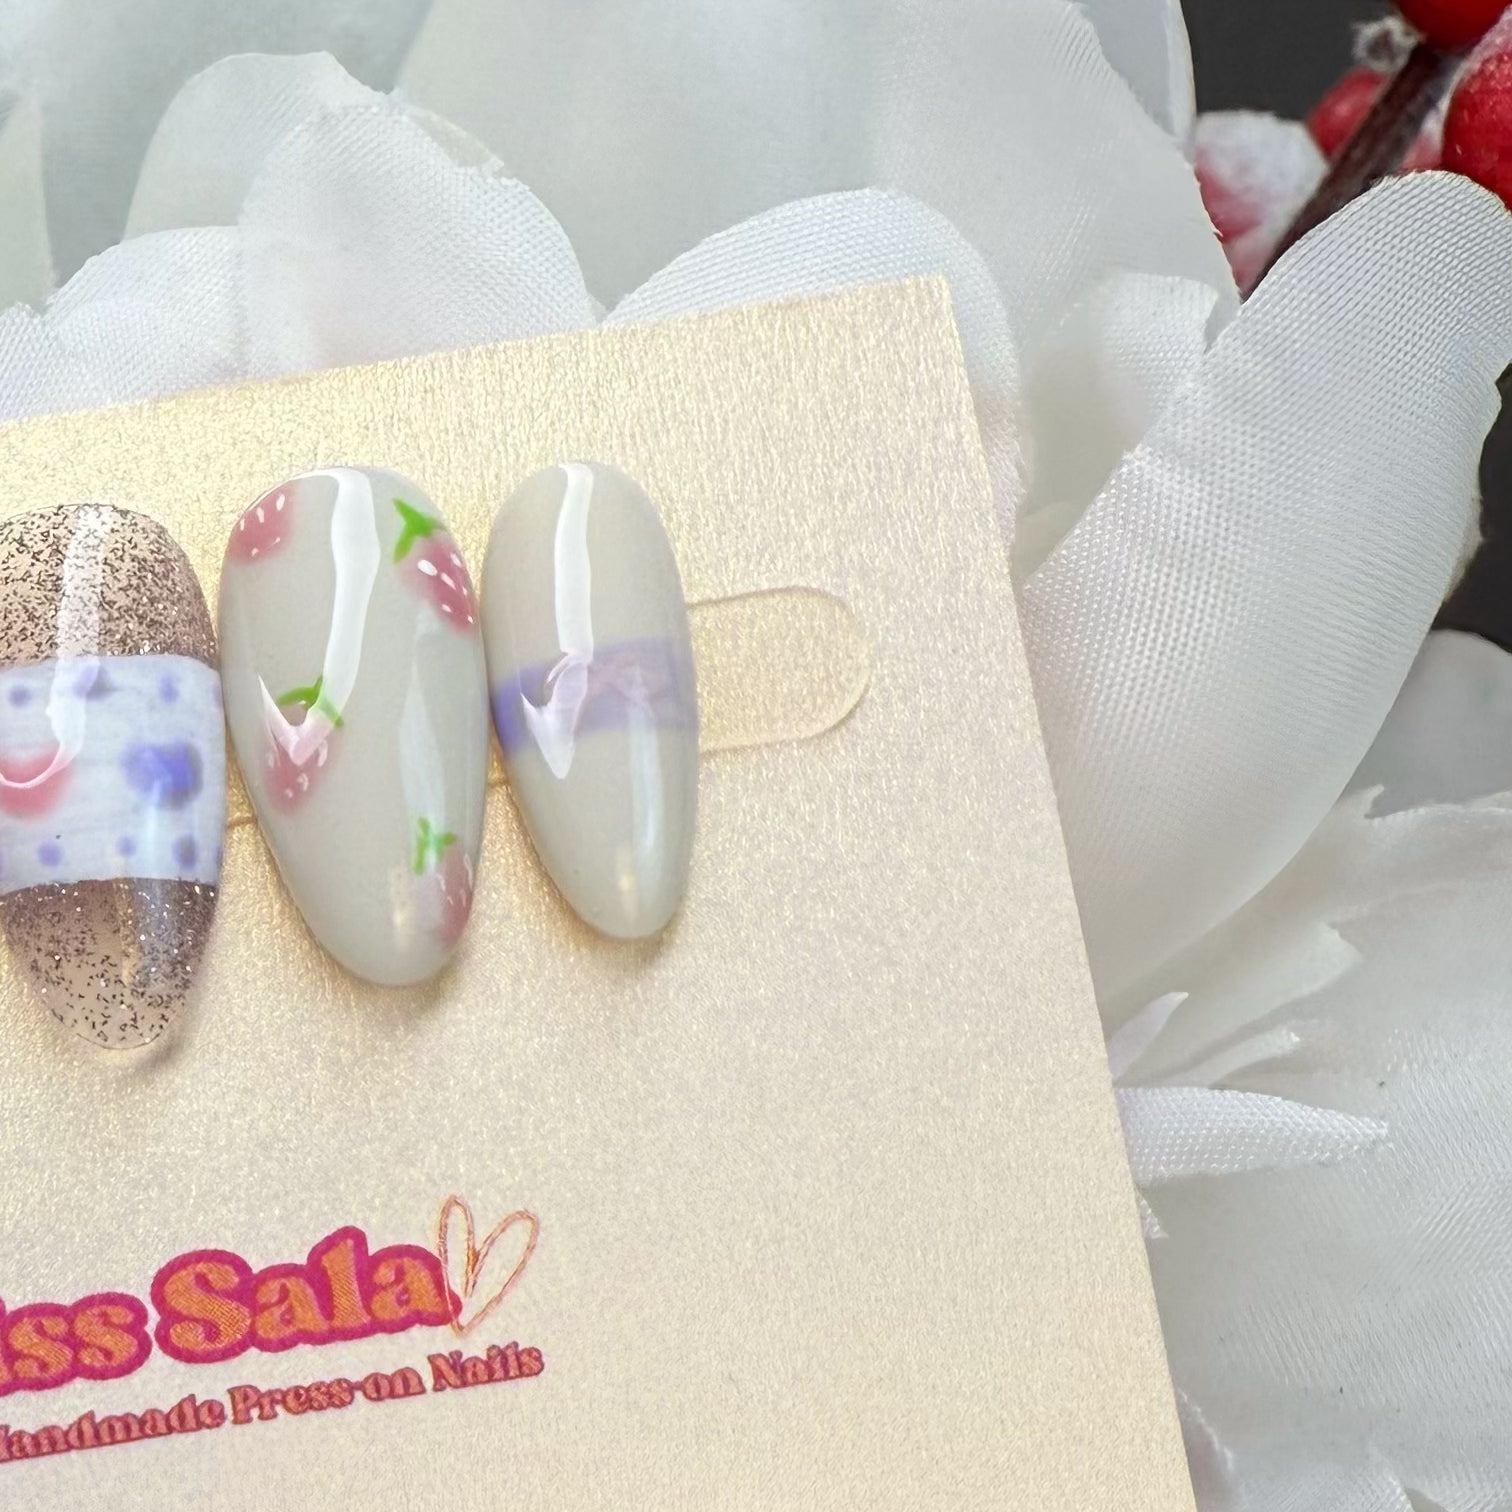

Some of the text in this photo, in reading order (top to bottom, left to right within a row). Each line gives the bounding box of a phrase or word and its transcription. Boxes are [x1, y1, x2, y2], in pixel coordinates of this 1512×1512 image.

[151, 1225, 462, 1363] Sala
[227, 1365, 424, 1425] Press-on
[428, 1341, 545, 1394] Nails
